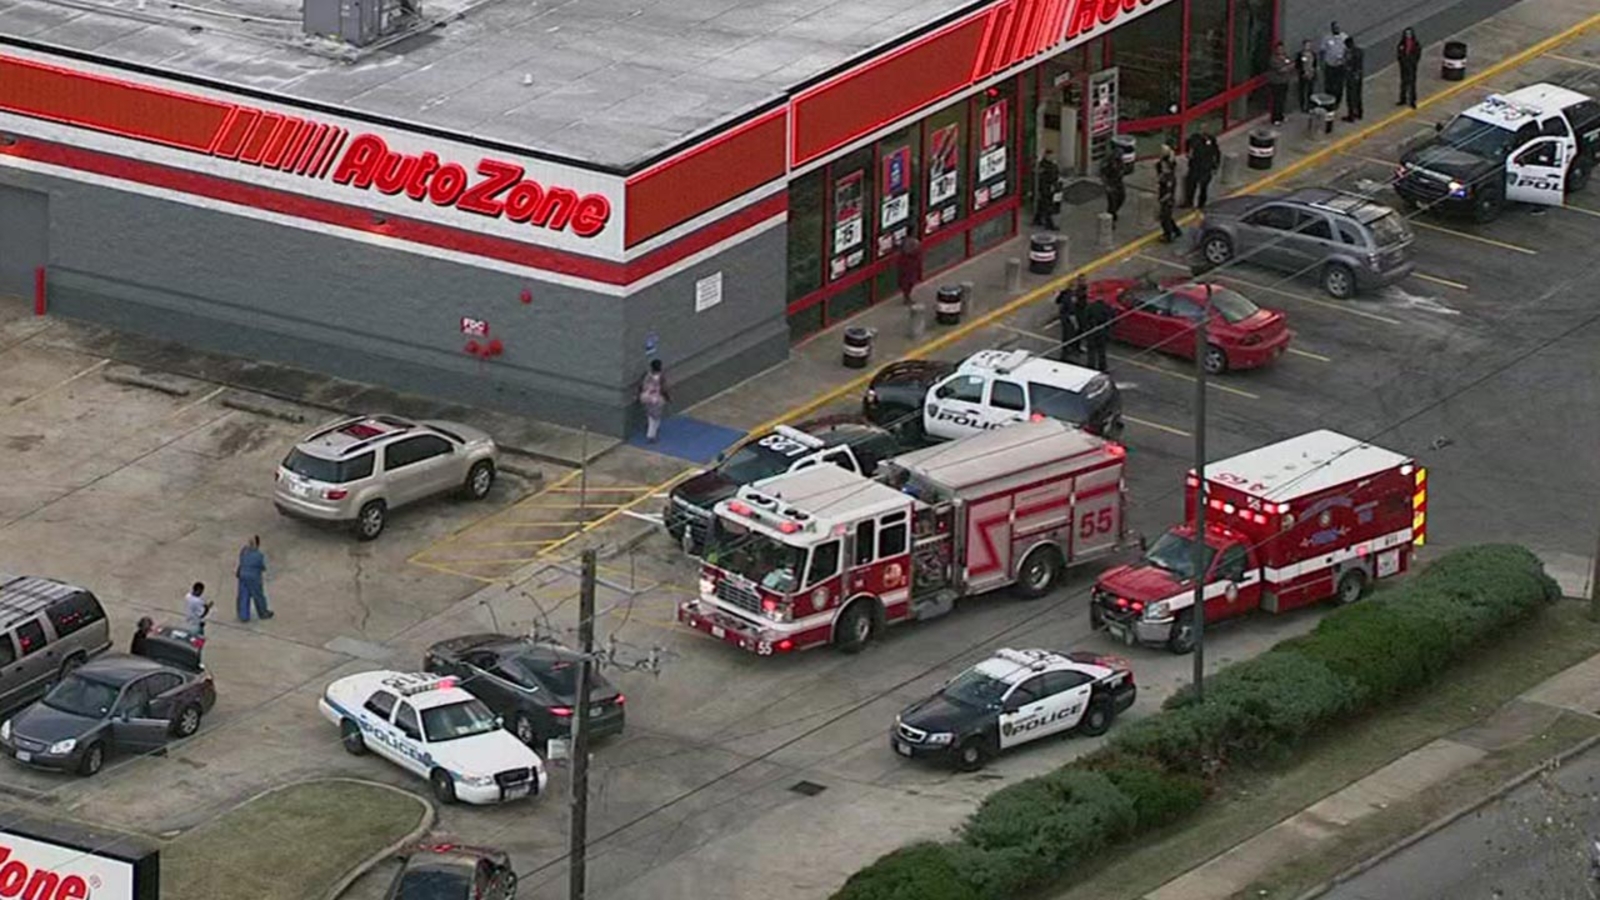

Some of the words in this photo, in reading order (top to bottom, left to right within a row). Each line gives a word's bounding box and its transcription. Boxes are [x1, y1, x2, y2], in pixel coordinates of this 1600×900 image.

[333, 133, 611, 237] AutoZone
[1080, 507, 1113, 539] 55
[758, 641, 772, 655] 55
[1011, 703, 1082, 737] POLICE
[360, 720, 419, 759] POLICE
